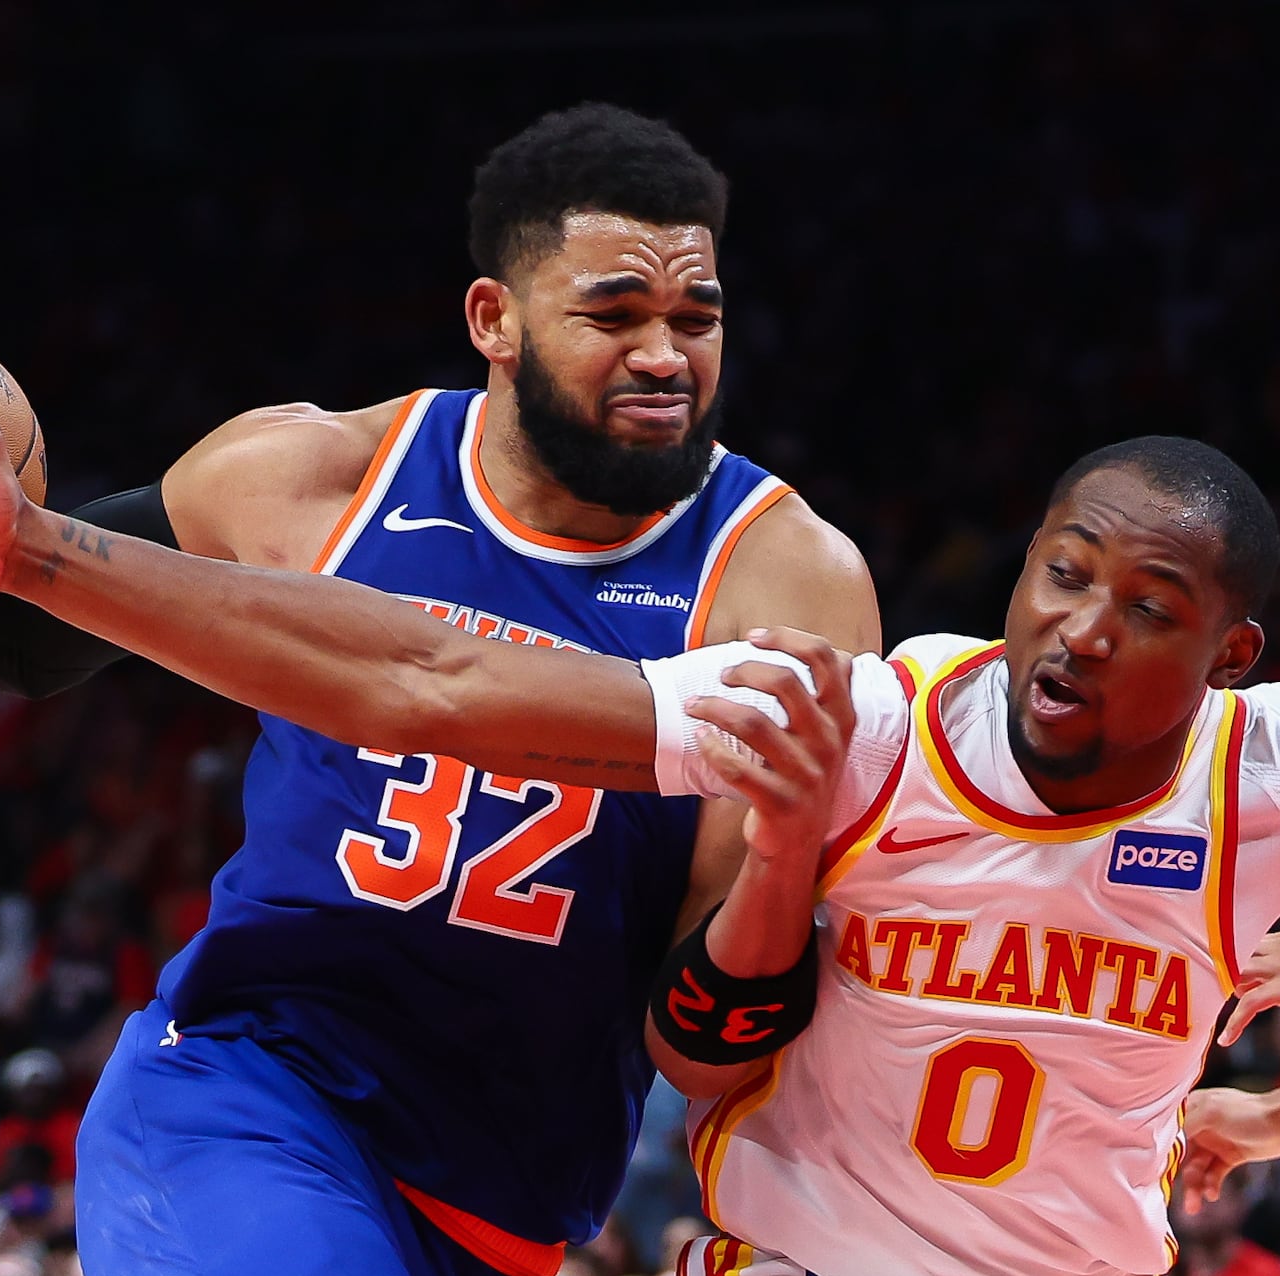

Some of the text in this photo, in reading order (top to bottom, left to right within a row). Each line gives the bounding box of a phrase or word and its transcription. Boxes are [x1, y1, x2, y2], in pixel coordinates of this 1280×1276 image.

[596, 590, 692, 612] abu dhabi
[337, 745, 603, 946] 32
[1115, 844, 1198, 872] paze
[836, 911, 1193, 1042] ATLANTA
[909, 1036, 1046, 1188] 0
